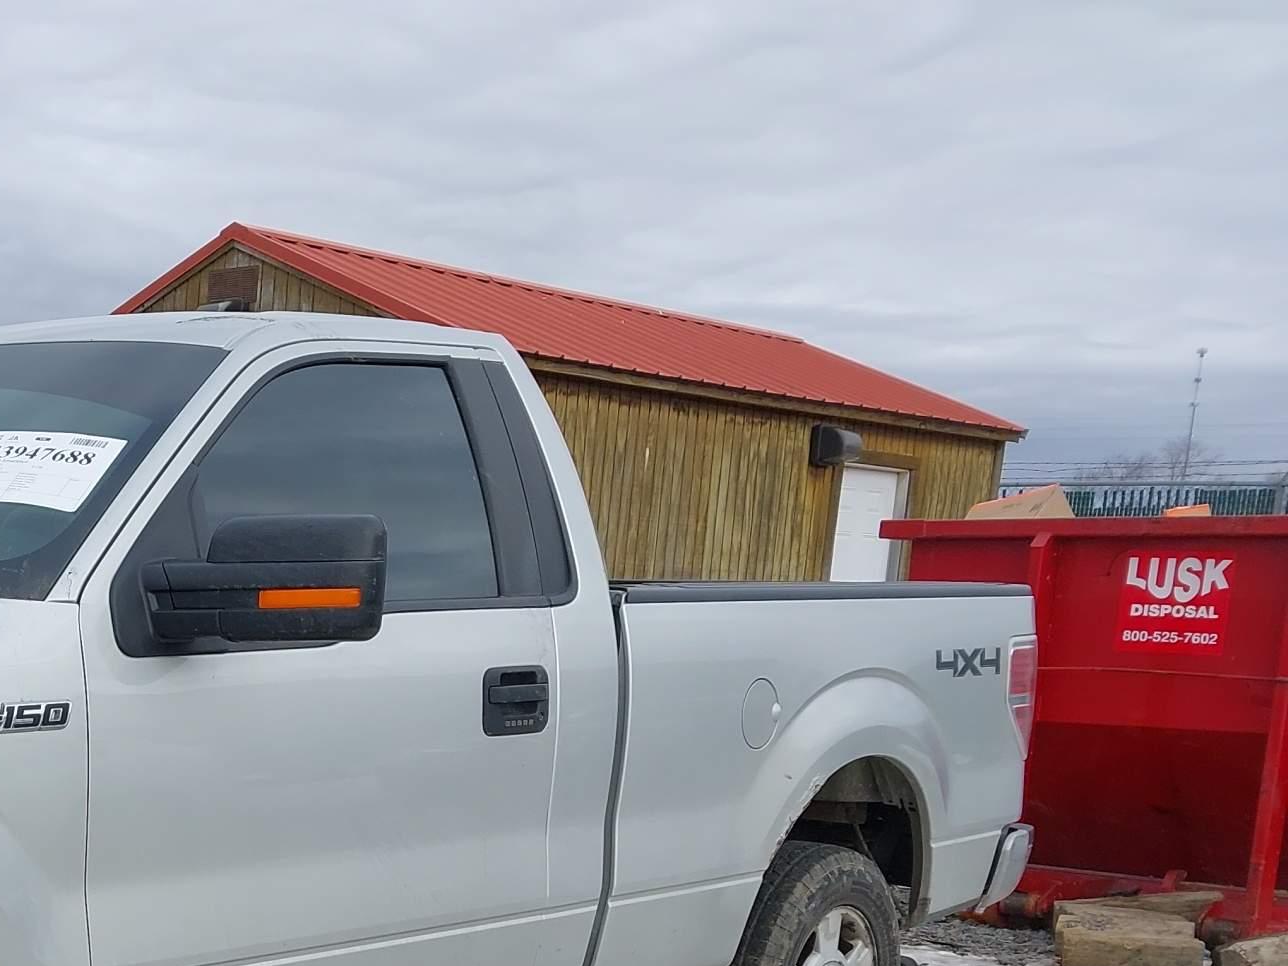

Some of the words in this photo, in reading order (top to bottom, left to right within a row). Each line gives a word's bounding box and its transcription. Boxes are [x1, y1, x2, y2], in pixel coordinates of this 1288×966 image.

[1126, 557, 1234, 603] LUSK
[1130, 604, 1219, 619] DISPOSAL
[1122, 630, 1218, 645] 800-525-7602
[936, 648, 1001, 677] 4X4
